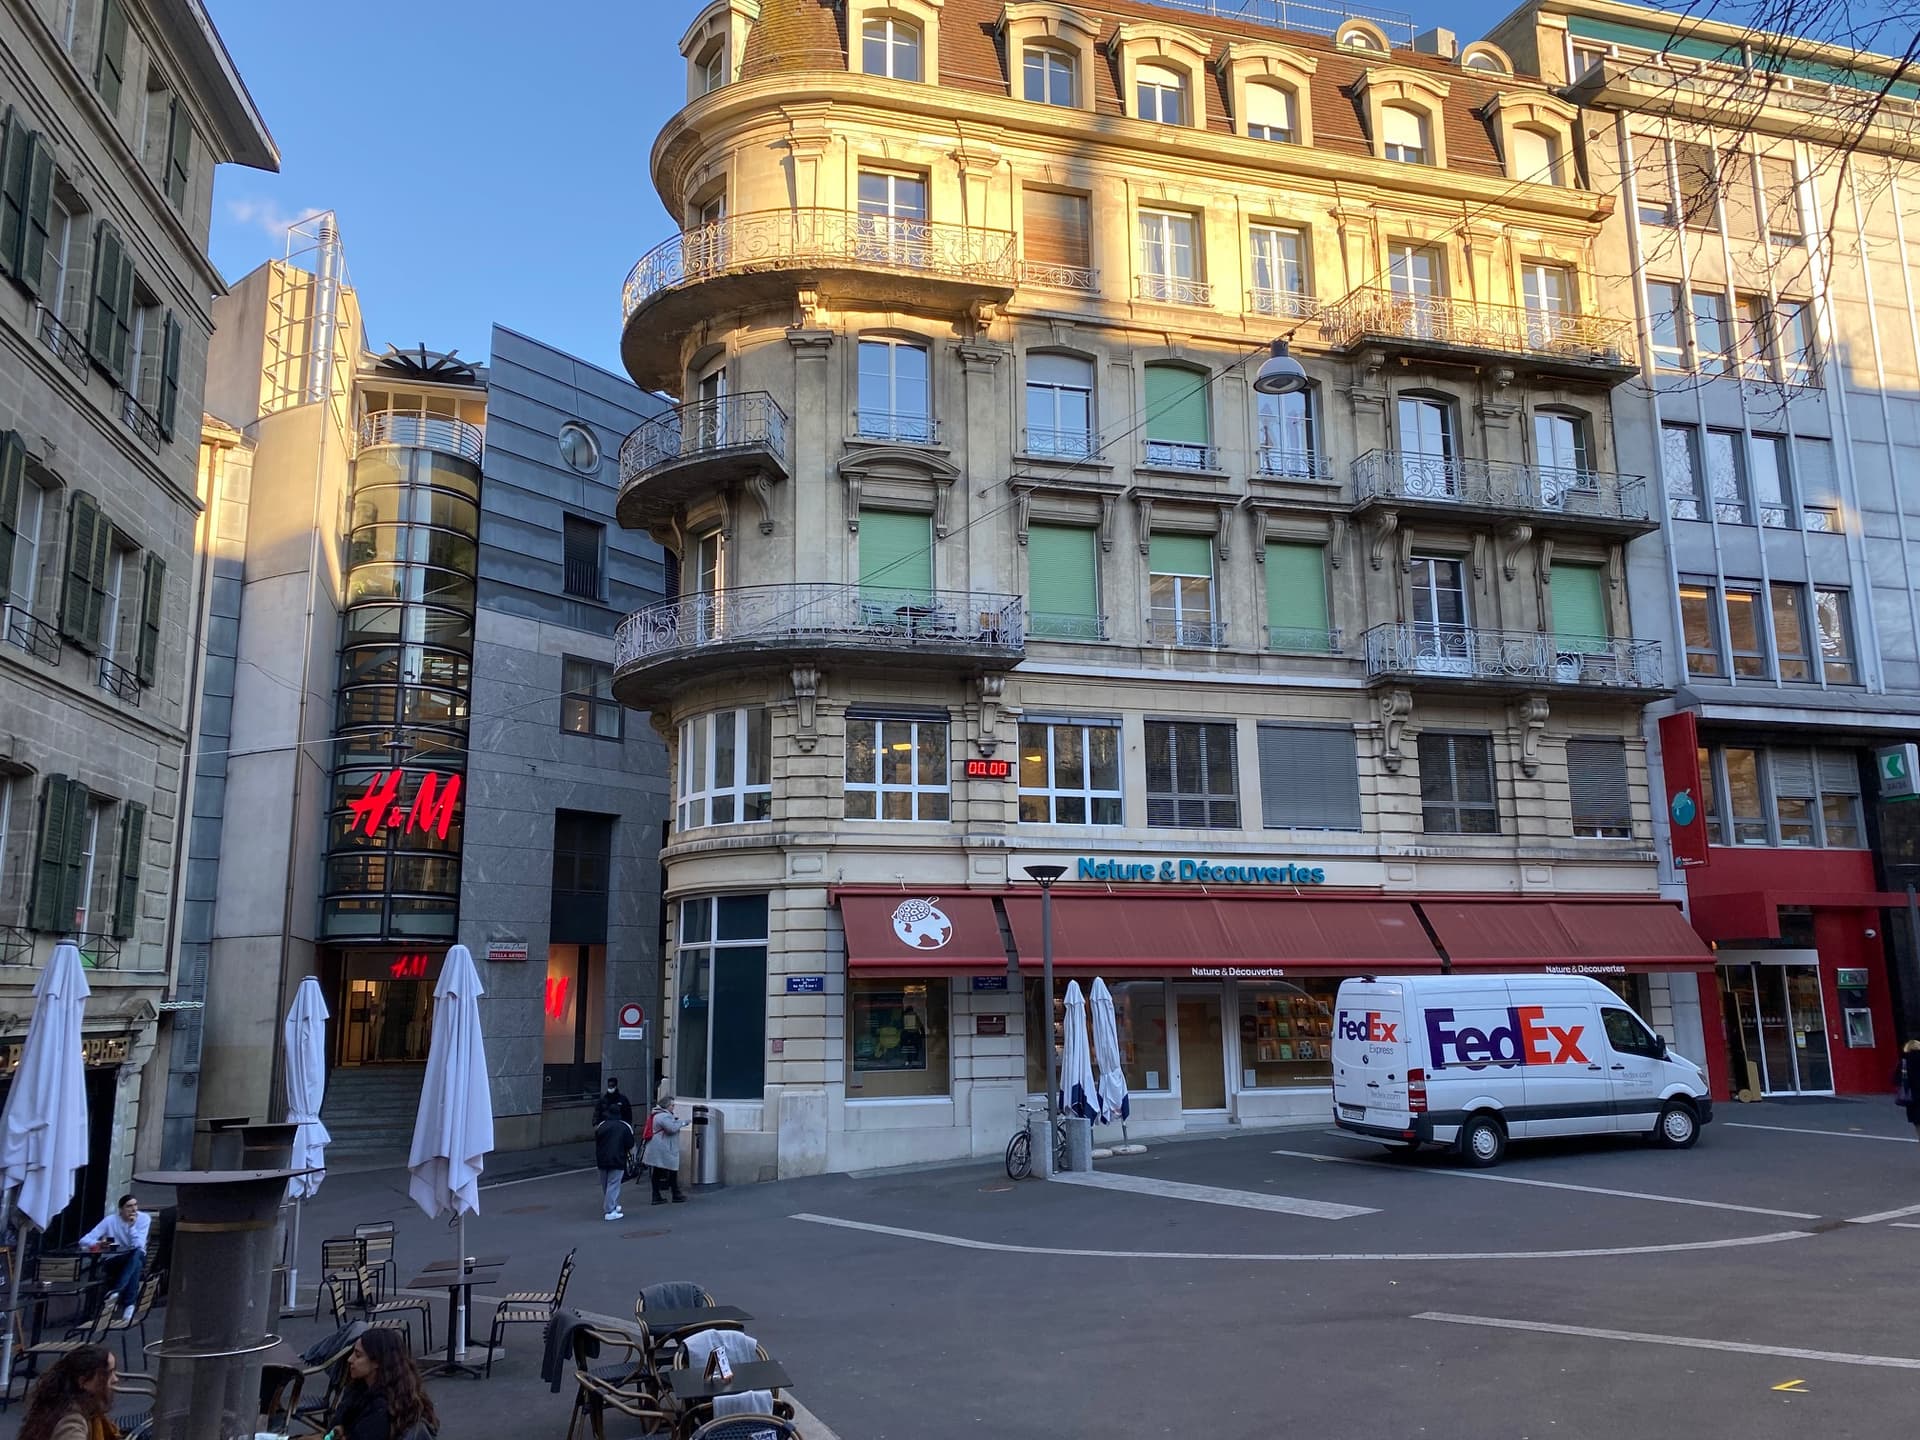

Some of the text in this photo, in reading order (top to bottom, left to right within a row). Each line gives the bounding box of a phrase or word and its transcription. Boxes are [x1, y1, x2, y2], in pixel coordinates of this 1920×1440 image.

[348, 768, 461, 840] H&M
[1077, 857, 1326, 884] Nature & Découvertes
[389, 953, 428, 978] H&M
[1191, 966, 1284, 976] Nature & Découvertes
[1545, 965, 1571, 973] Nature
[1578, 964, 1626, 973] Découvertes
[1339, 1010, 1399, 1043] FedEx
[1424, 1005, 1592, 1072] FedEx
[1369, 1044, 1394, 1055] Express
